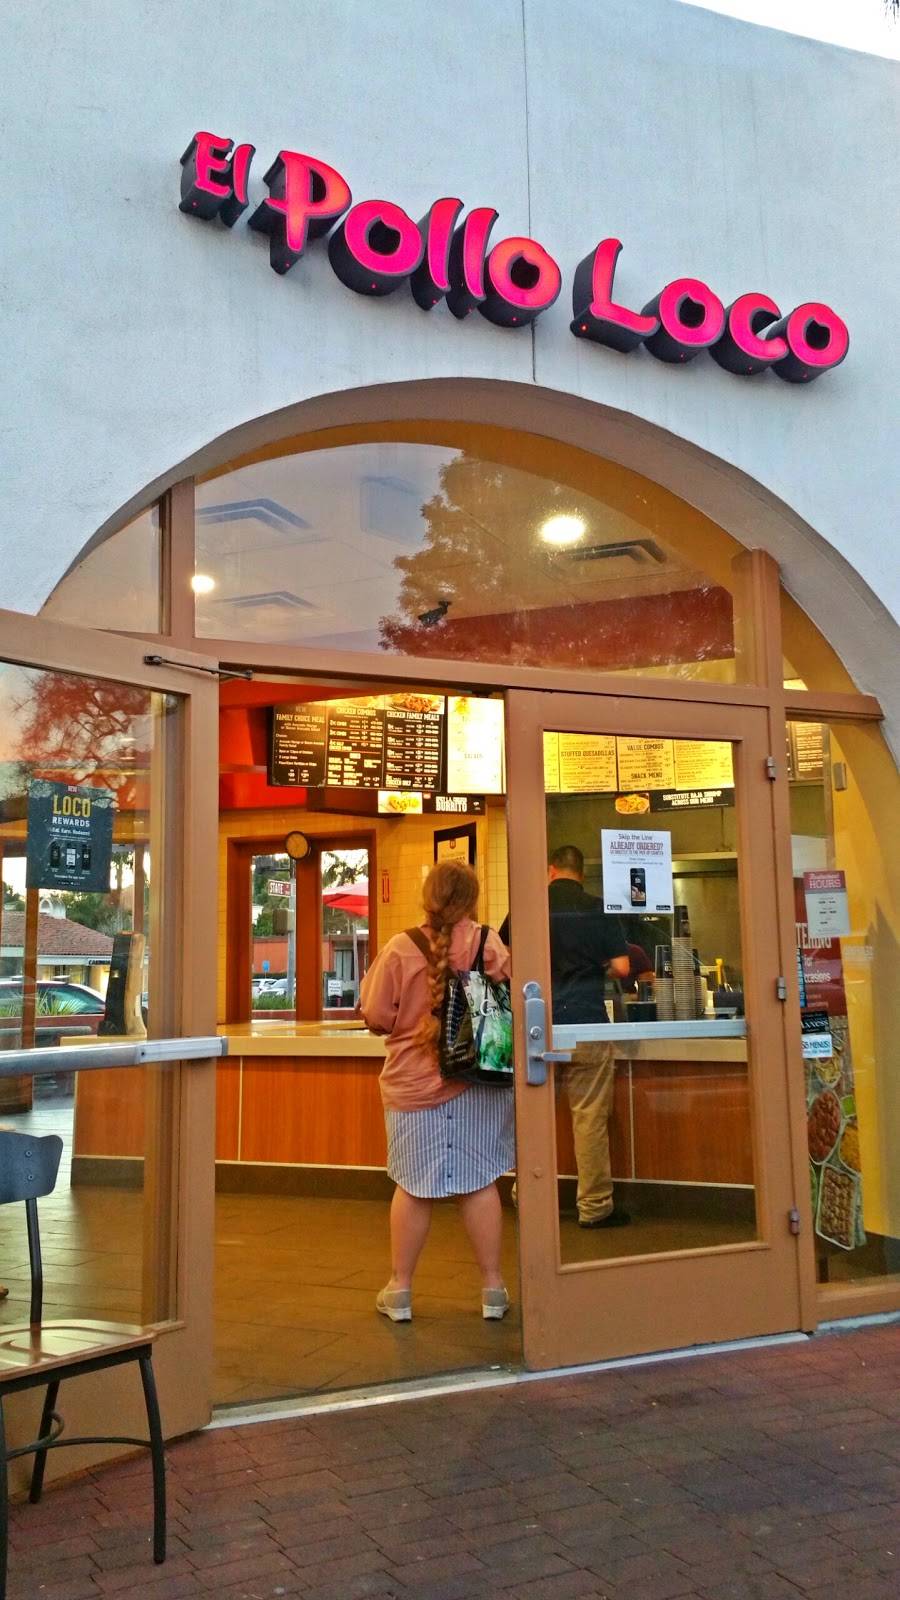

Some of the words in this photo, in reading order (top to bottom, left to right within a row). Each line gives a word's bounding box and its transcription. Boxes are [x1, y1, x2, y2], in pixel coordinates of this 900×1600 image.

[257, 149, 561, 320] Pollo
[577, 238, 849, 377] Loco
[276, 713, 293, 721] FAMILY
[406, 712, 423, 721] FAMILY
[582, 749, 615, 757] QUESADILLAS
[53, 794, 91, 818] LOCO
[52, 816, 91, 828] REWARDS
[618, 833, 631, 841] Skip
[610, 841, 635, 850] ALREADY
[636, 842, 664, 851] ORDERED?
[809, 879, 842, 889] HOURS
